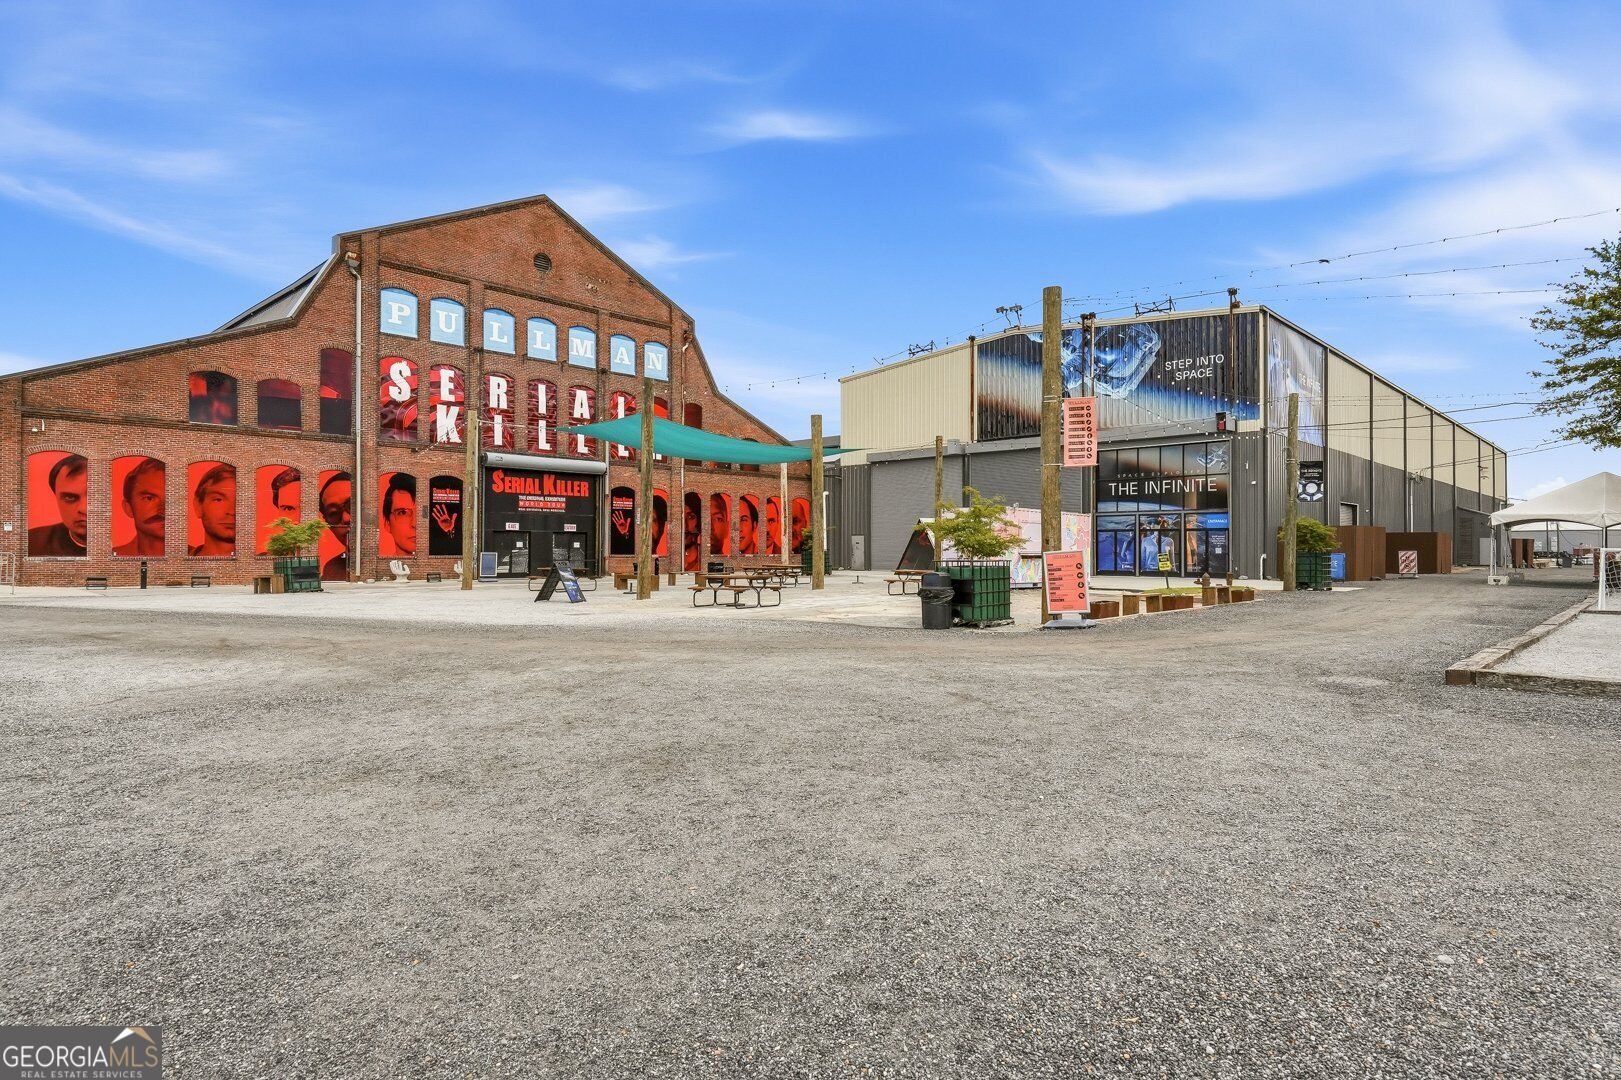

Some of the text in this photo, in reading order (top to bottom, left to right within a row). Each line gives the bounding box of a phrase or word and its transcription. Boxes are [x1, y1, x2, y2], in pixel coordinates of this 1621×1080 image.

[387, 301, 664, 371] PULLMAN
[1165, 353, 1225, 371] STEP INTO
[1175, 367, 1213, 381] SPACE
[435, 404, 663, 460] KILL
[492, 469, 589, 497] SERIAL KILLER
[1108, 477, 1217, 496] THE INFINITE
